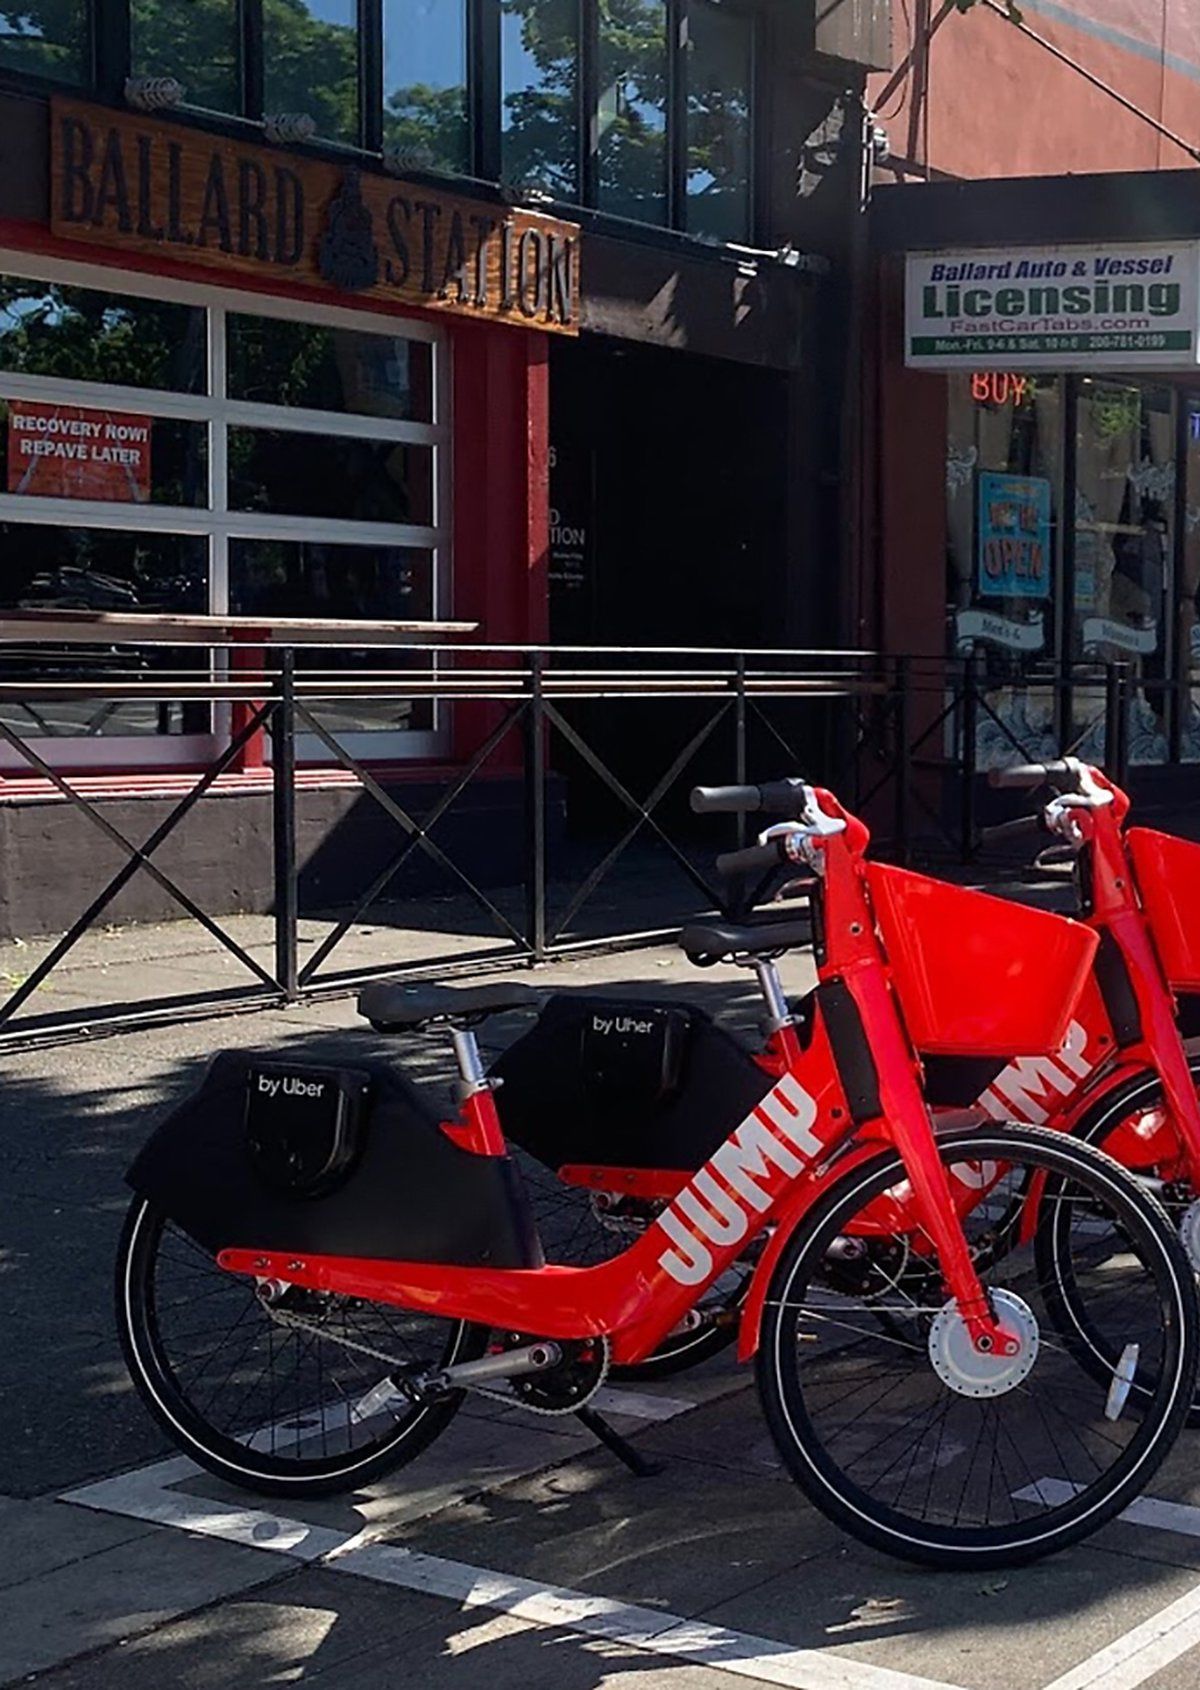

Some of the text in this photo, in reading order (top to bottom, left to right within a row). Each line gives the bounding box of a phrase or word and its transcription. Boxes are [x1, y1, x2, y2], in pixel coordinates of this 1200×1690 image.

[62, 115, 575, 325] BALLARD STATION
[930, 255, 1174, 281] Ballard Auto & Vessel
[922, 280, 1181, 318] Licensing
[949, 316, 1150, 334] FastCarTabs.com
[972, 373, 1026, 405] BUY
[13, 415, 148, 442] RECOVERY NOW!
[20, 440, 141, 464] REPAVE LATER
[593, 1015, 613, 1035] by
[258, 1074, 325, 1097] by Uber
[656, 1071, 825, 1287] JUMP
